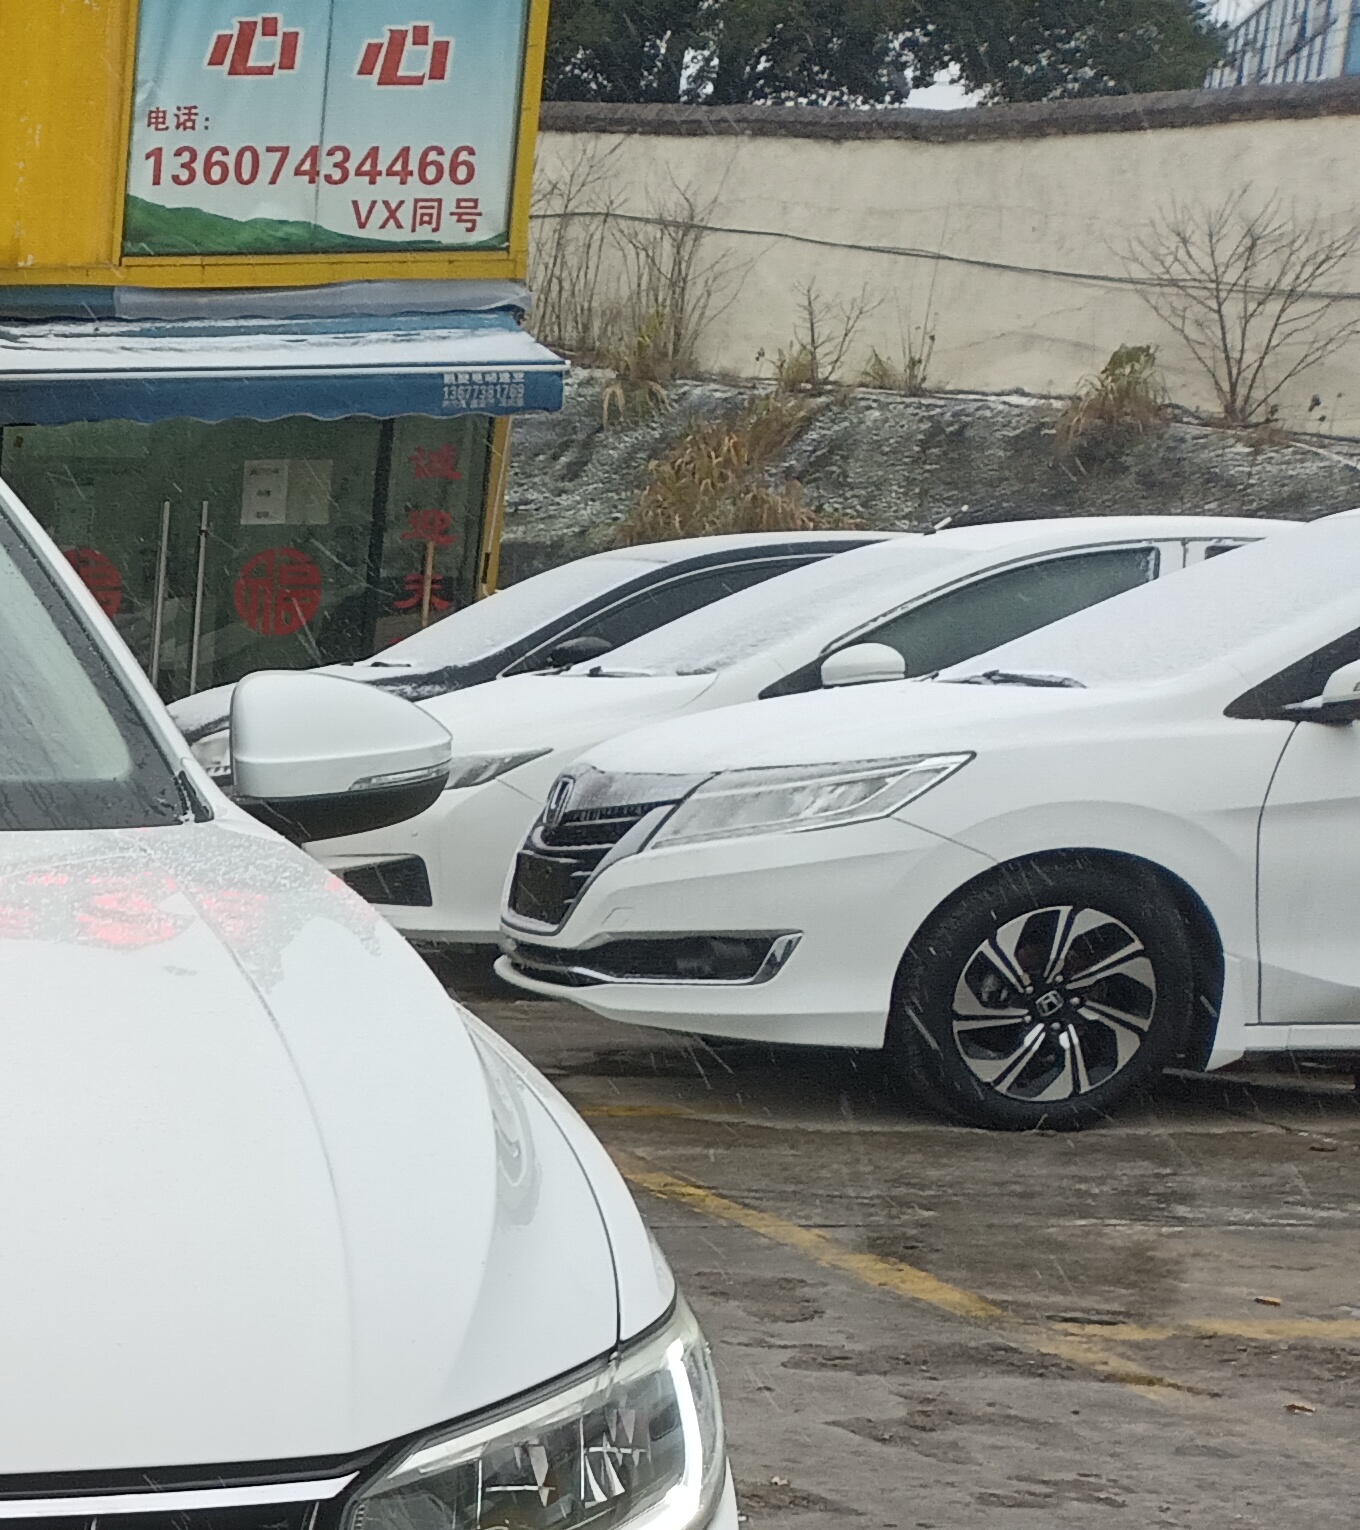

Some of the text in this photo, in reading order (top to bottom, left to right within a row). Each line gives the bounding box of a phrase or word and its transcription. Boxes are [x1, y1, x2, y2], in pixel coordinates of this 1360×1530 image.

[206, 16, 451, 86] 心 心
[146, 105, 211, 132] 电话：
[144, 144, 478, 187] 13607434466
[351, 197, 483, 234] VX同号
